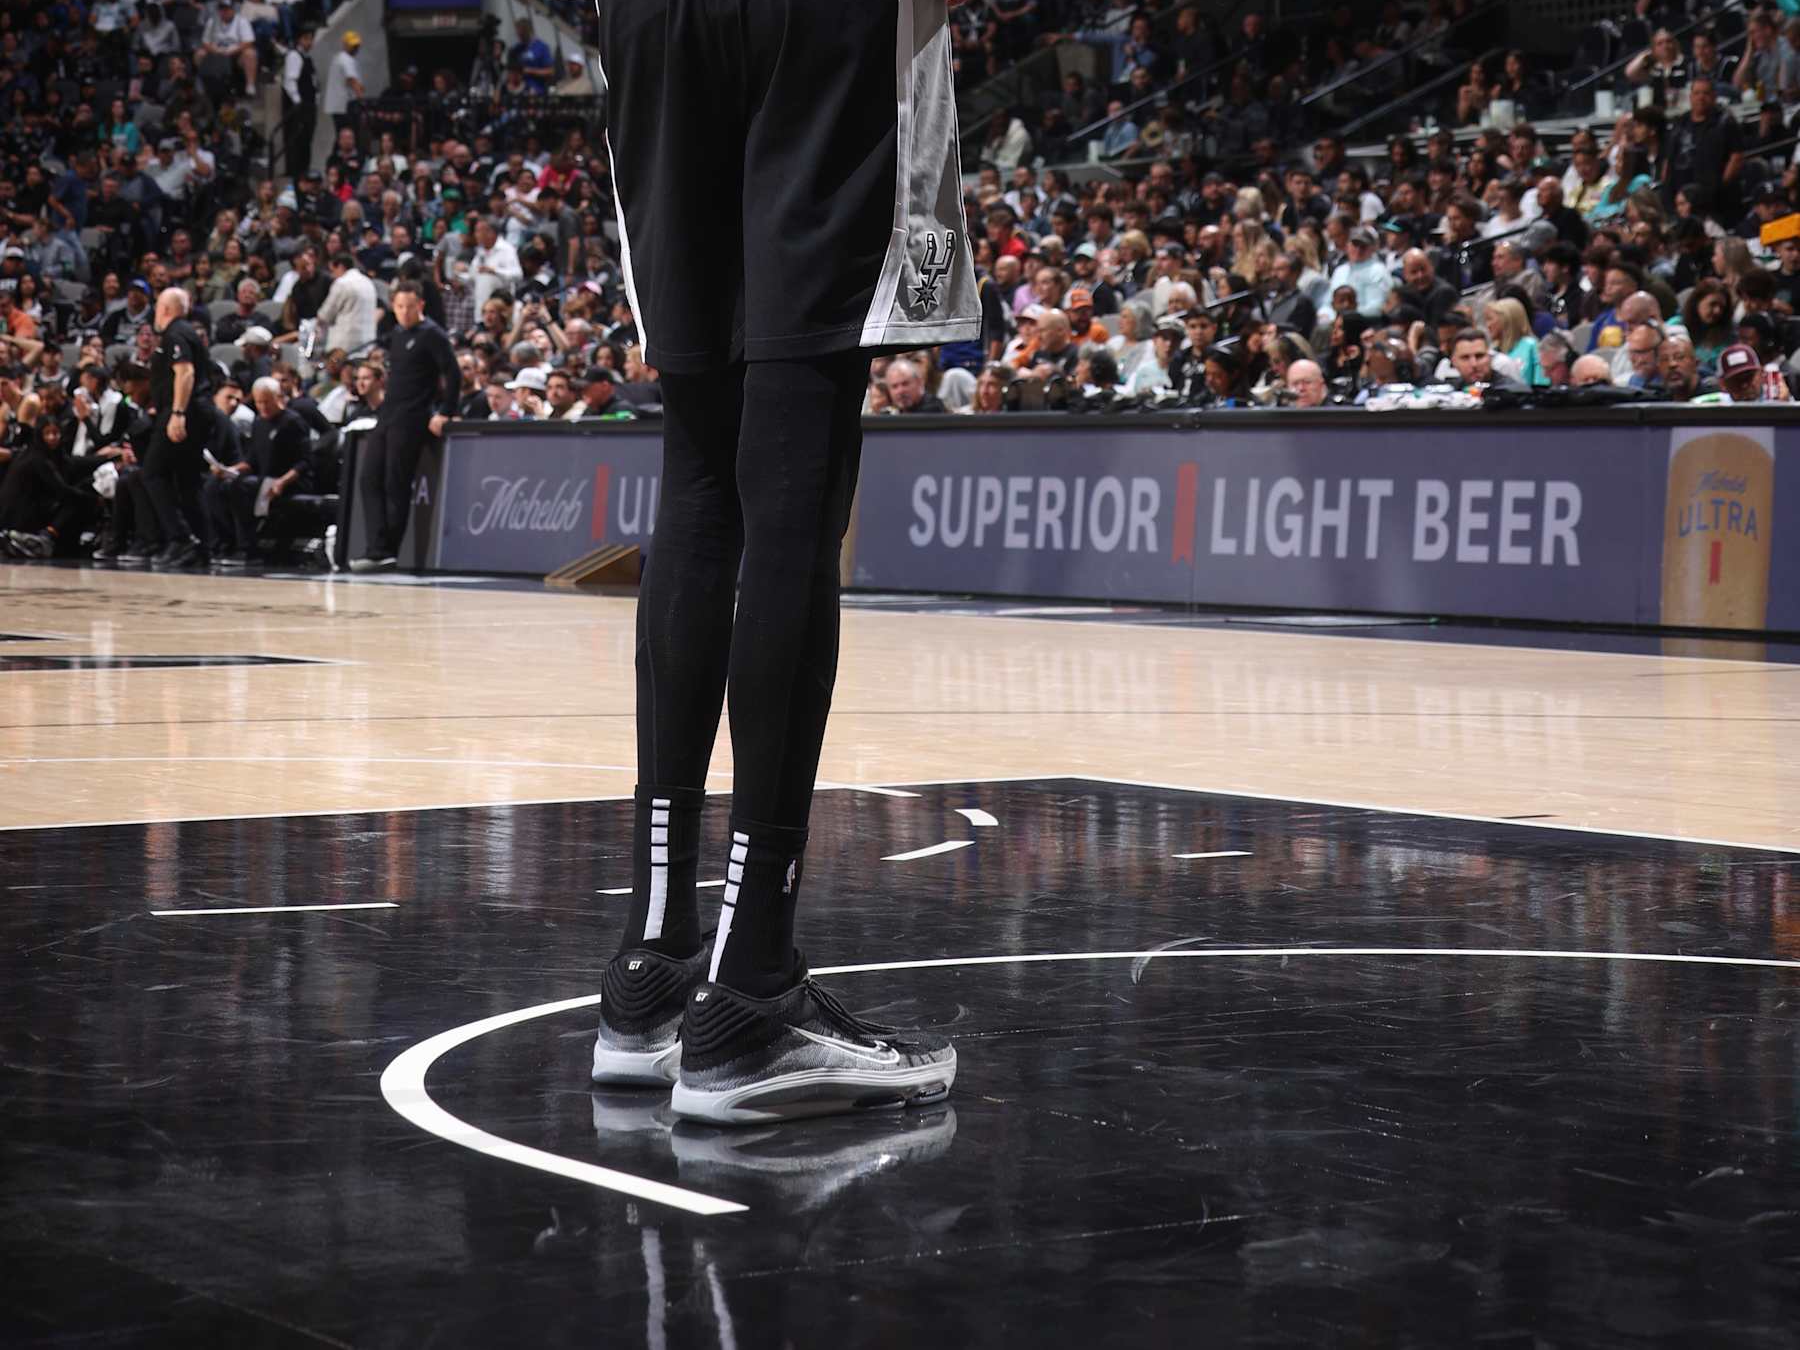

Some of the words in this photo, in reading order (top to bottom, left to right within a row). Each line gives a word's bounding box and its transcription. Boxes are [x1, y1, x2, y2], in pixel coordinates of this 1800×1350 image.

[467, 475, 589, 536] Michelob
[909, 474, 1161, 553] SUPERIOR
[1210, 476, 1394, 560] LIGHT
[1413, 479, 1582, 567] BEER
[1677, 497, 1759, 542] ULTRA
[628, 960, 643, 971] GT
[695, 991, 709, 1002] GT
